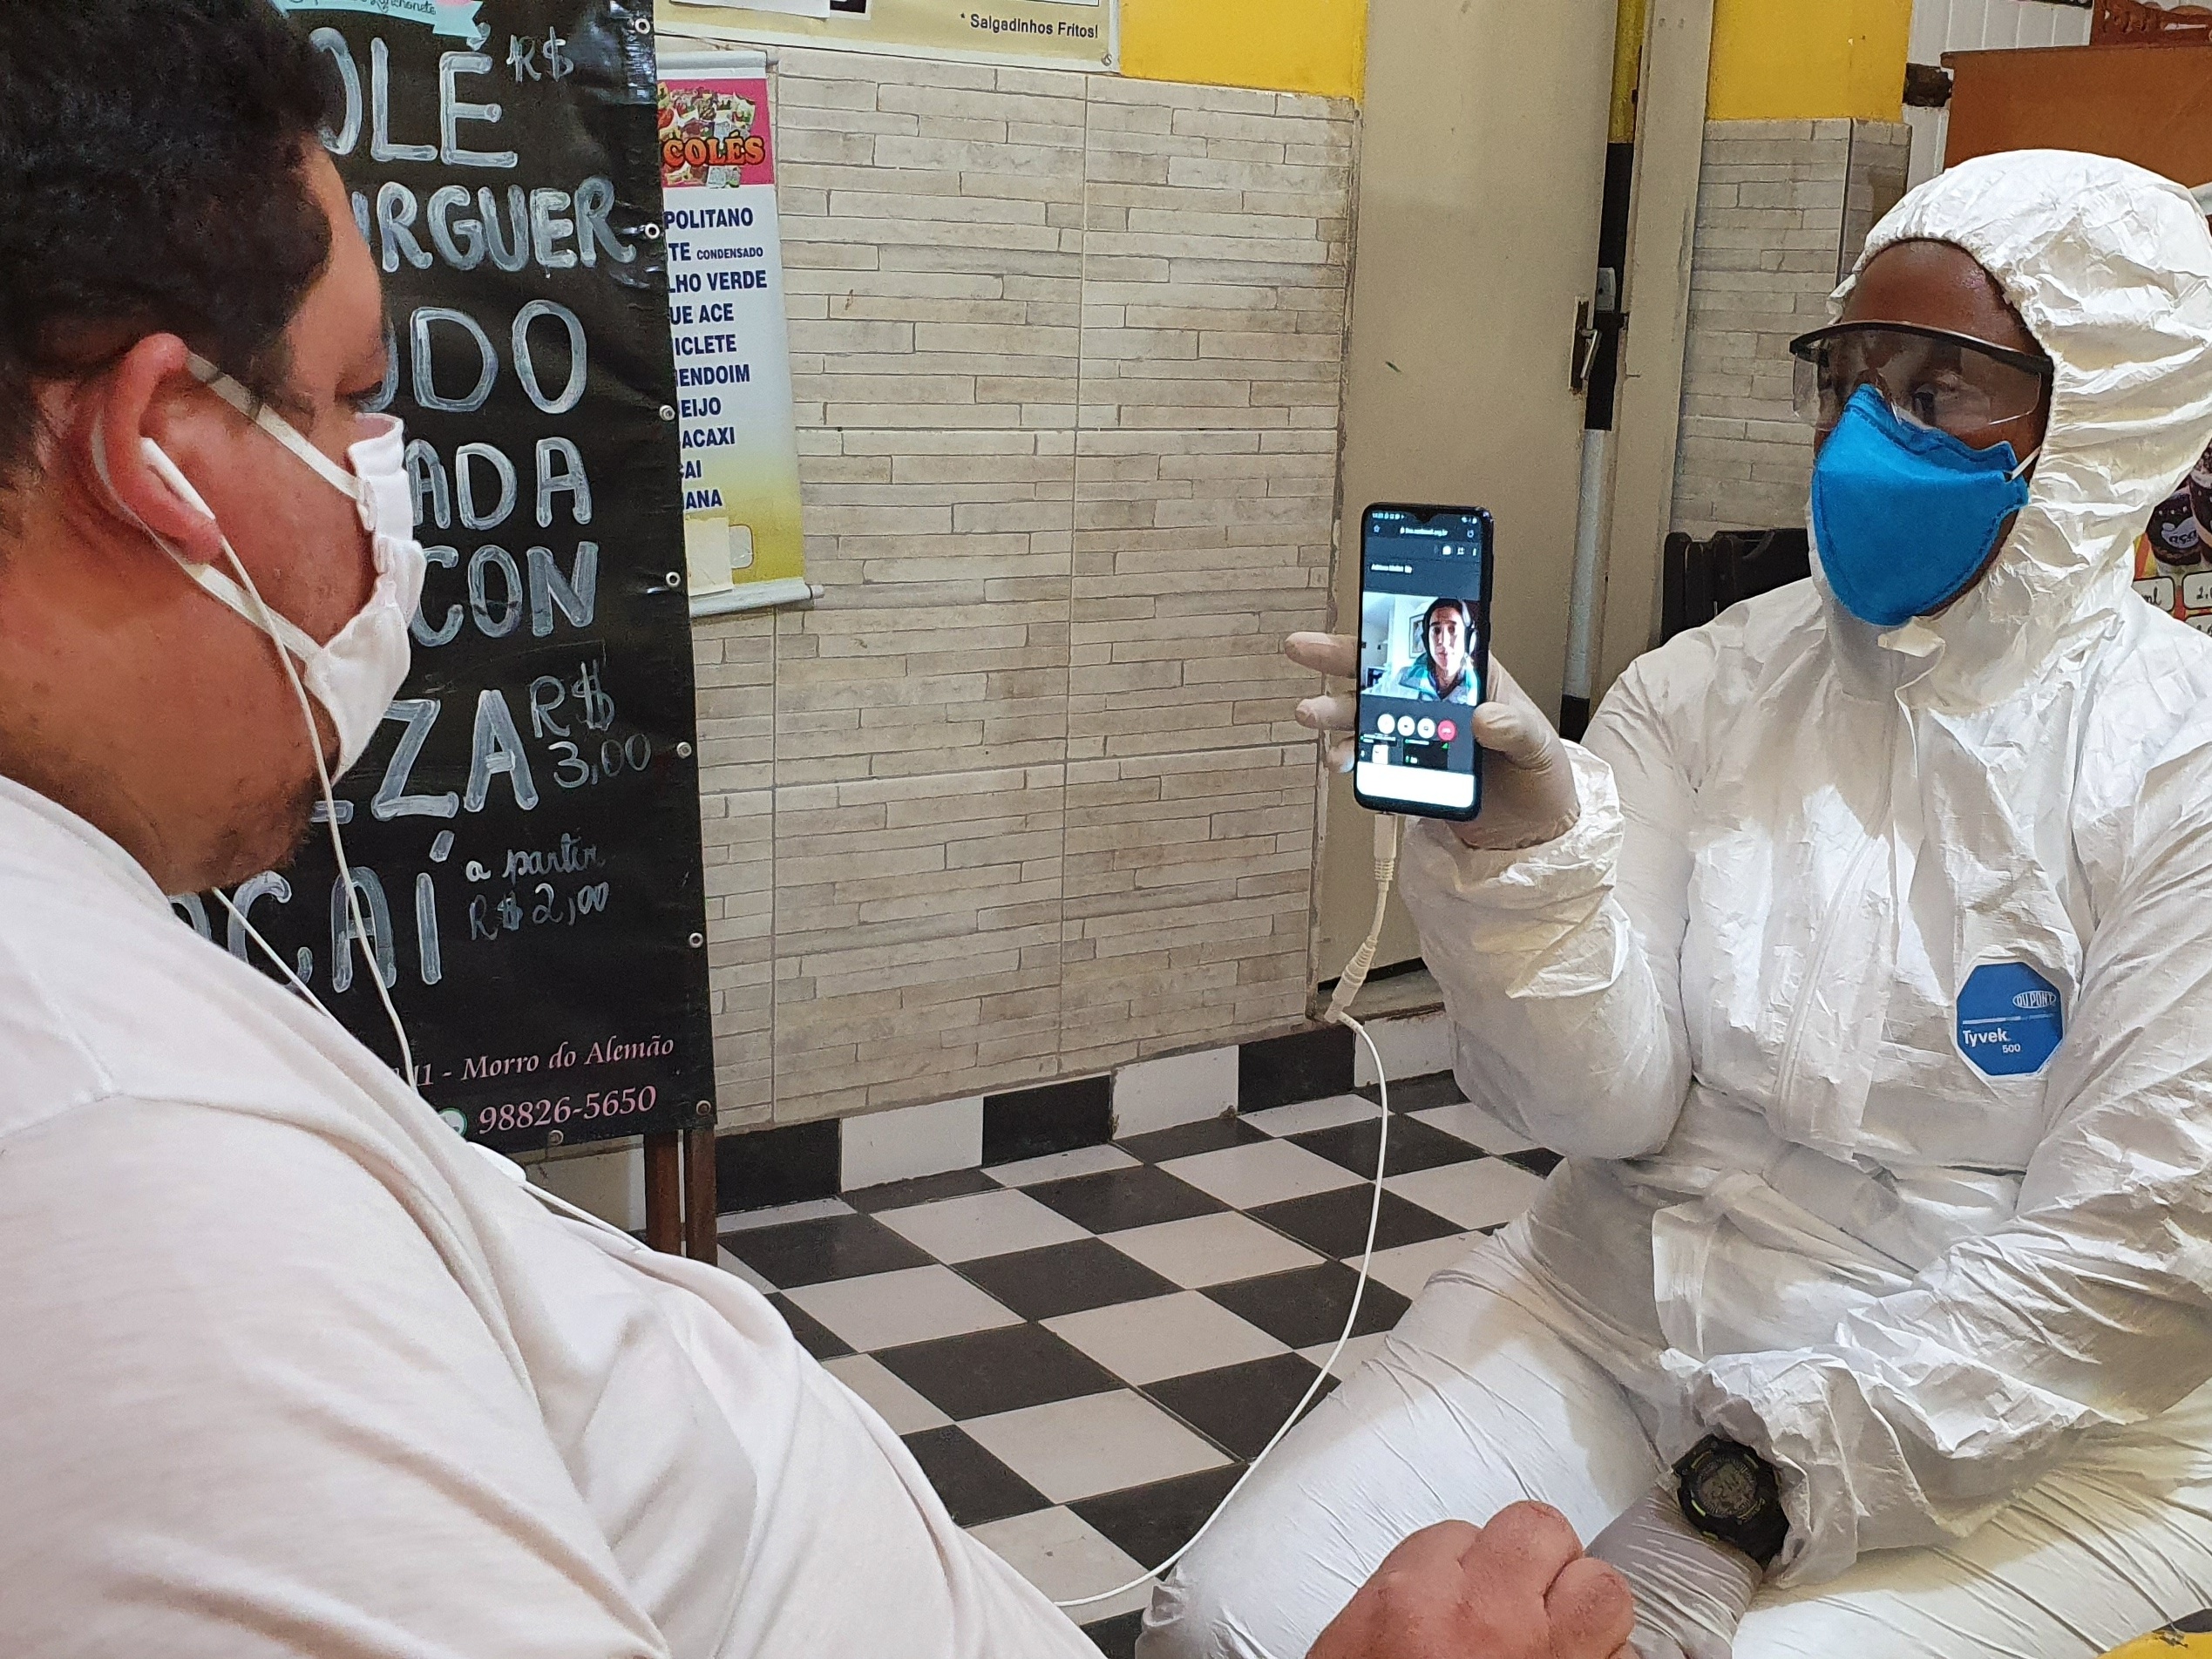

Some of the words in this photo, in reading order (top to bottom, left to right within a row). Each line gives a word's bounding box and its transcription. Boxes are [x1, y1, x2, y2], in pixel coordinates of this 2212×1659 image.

[970, 13, 1053, 34] Salgadinhos
[662, 131, 765, 166] COLÉS
[664, 207, 754, 230] POLITANO
[668, 242, 691, 261] TE
[696, 247, 764, 261] CONDENSADO
[707, 270, 767, 291] VERDE
[699, 303, 734, 323] ACE
[675, 335, 736, 356] ICLETE
[675, 364, 750, 387] ENDOIM
[681, 396, 722, 418] EIJO
[682, 427, 735, 449] ACAXI
[405, 437, 593, 530] ADA
[686, 489, 723, 510] ANA
[311, 689, 539, 823] ZA
[530, 660, 615, 738] R$
[548, 734, 651, 788] 3,00
[465, 860, 491, 882] a
[470, 890, 524, 940] R$
[533, 882, 609, 925] 2,00
[1962, 1028, 2008, 1047] Tyvek
[2002, 1044, 2021, 1053] 500
[460, 1054, 539, 1080] Morro
[548, 1041, 577, 1069] do
[583, 1035, 674, 1065] Alemão
[478, 1085, 657, 1134] 98826-5650
